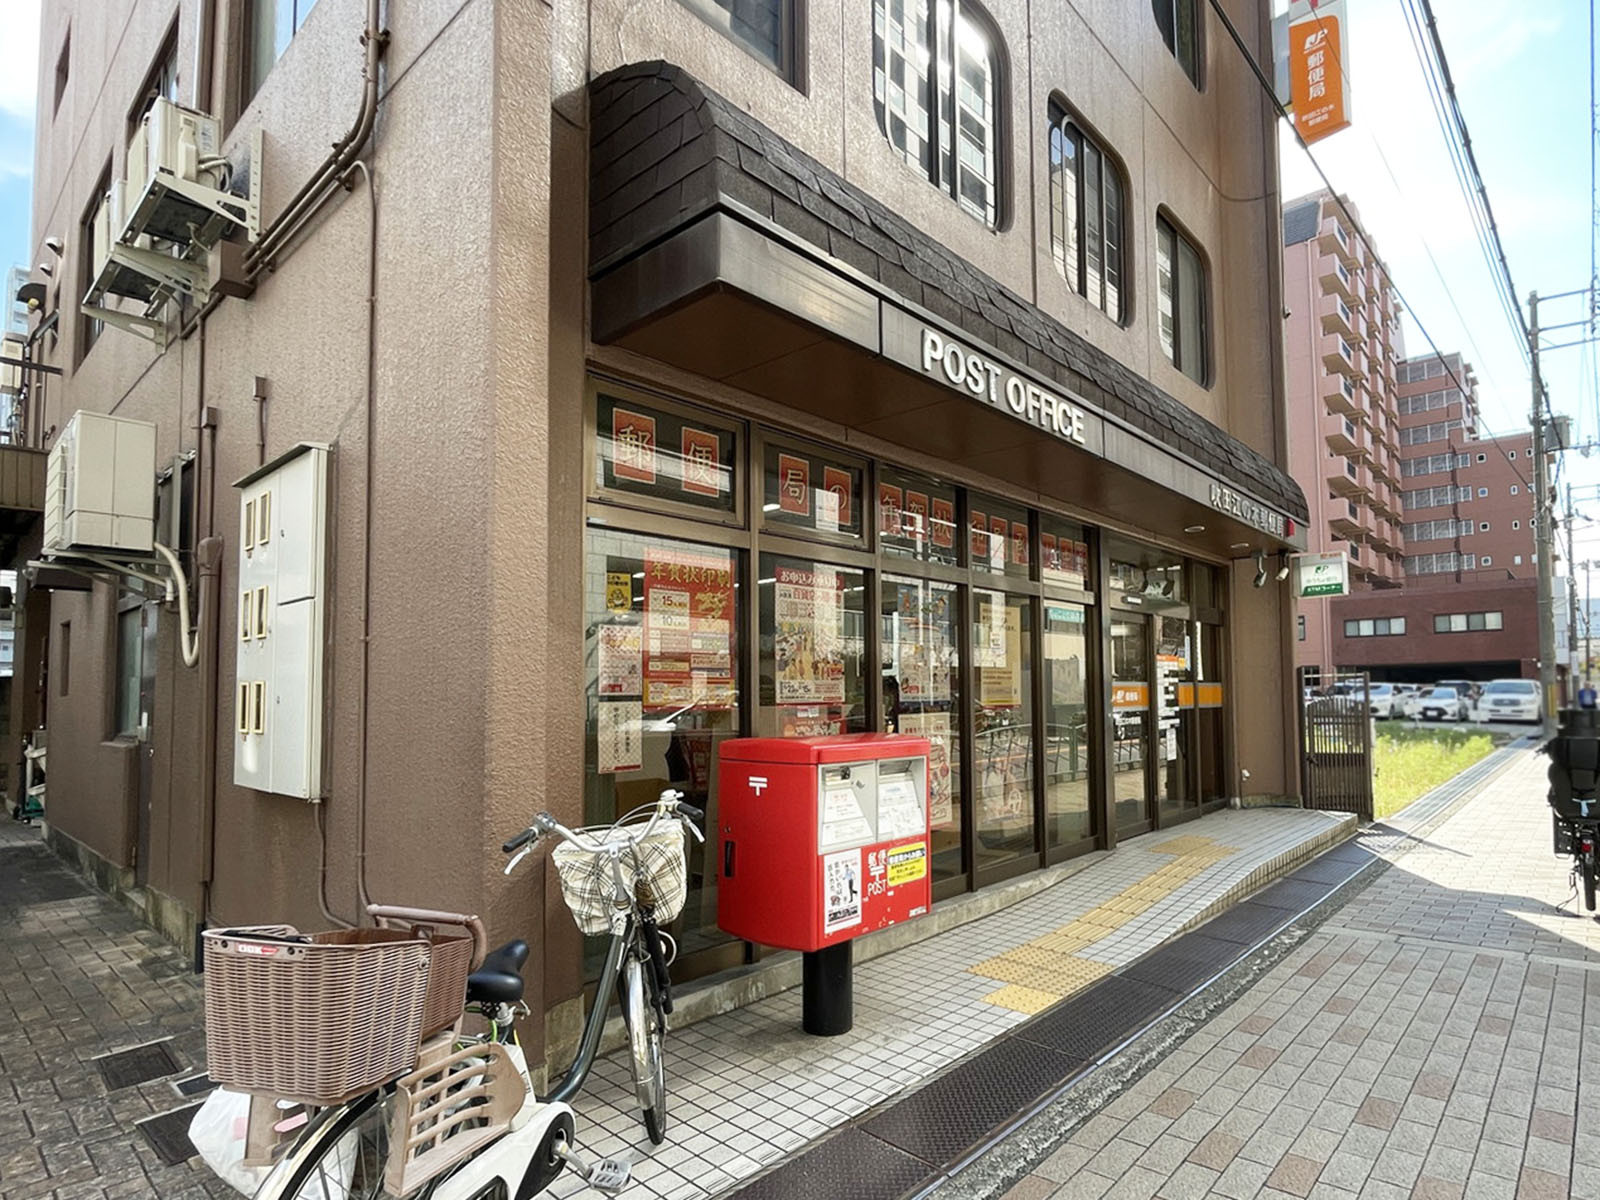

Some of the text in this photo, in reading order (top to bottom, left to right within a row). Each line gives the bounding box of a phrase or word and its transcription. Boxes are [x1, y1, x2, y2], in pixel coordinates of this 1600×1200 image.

[922, 328, 1086, 445] POST OFFICE
[616, 424, 712, 483] 郵便
[868, 879, 887, 897] POST
